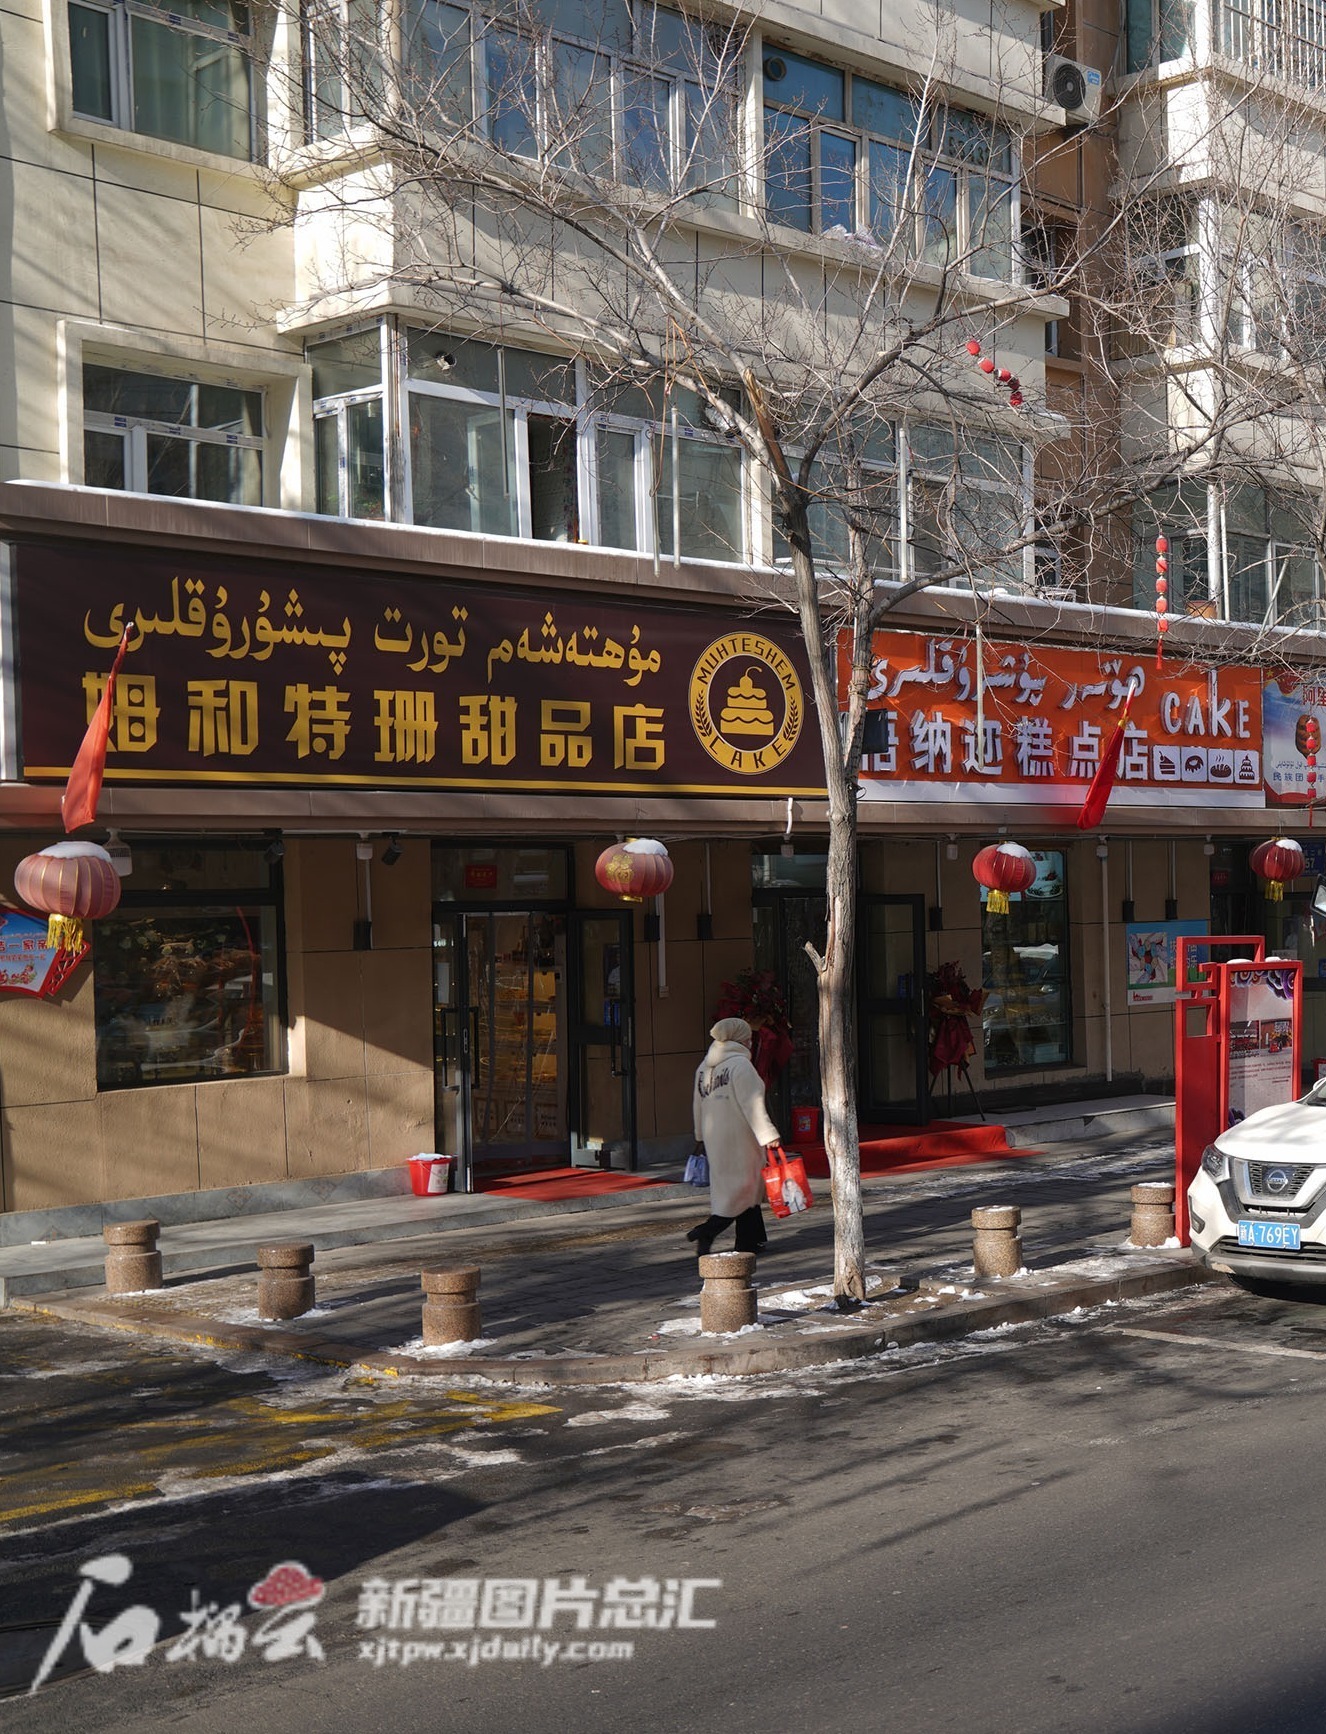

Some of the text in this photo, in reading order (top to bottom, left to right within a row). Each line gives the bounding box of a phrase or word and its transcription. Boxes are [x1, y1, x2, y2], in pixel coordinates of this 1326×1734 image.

[373, 605, 469, 674] تورت
[487, 611, 662, 687] مۇھتەشەم
[696, 637, 797, 691] MUHTESHEM
[82, 670, 667, 772] 姆和特珊甜品店
[1160, 668, 1251, 739] CAKE
[708, 735, 787, 769] CAKE
